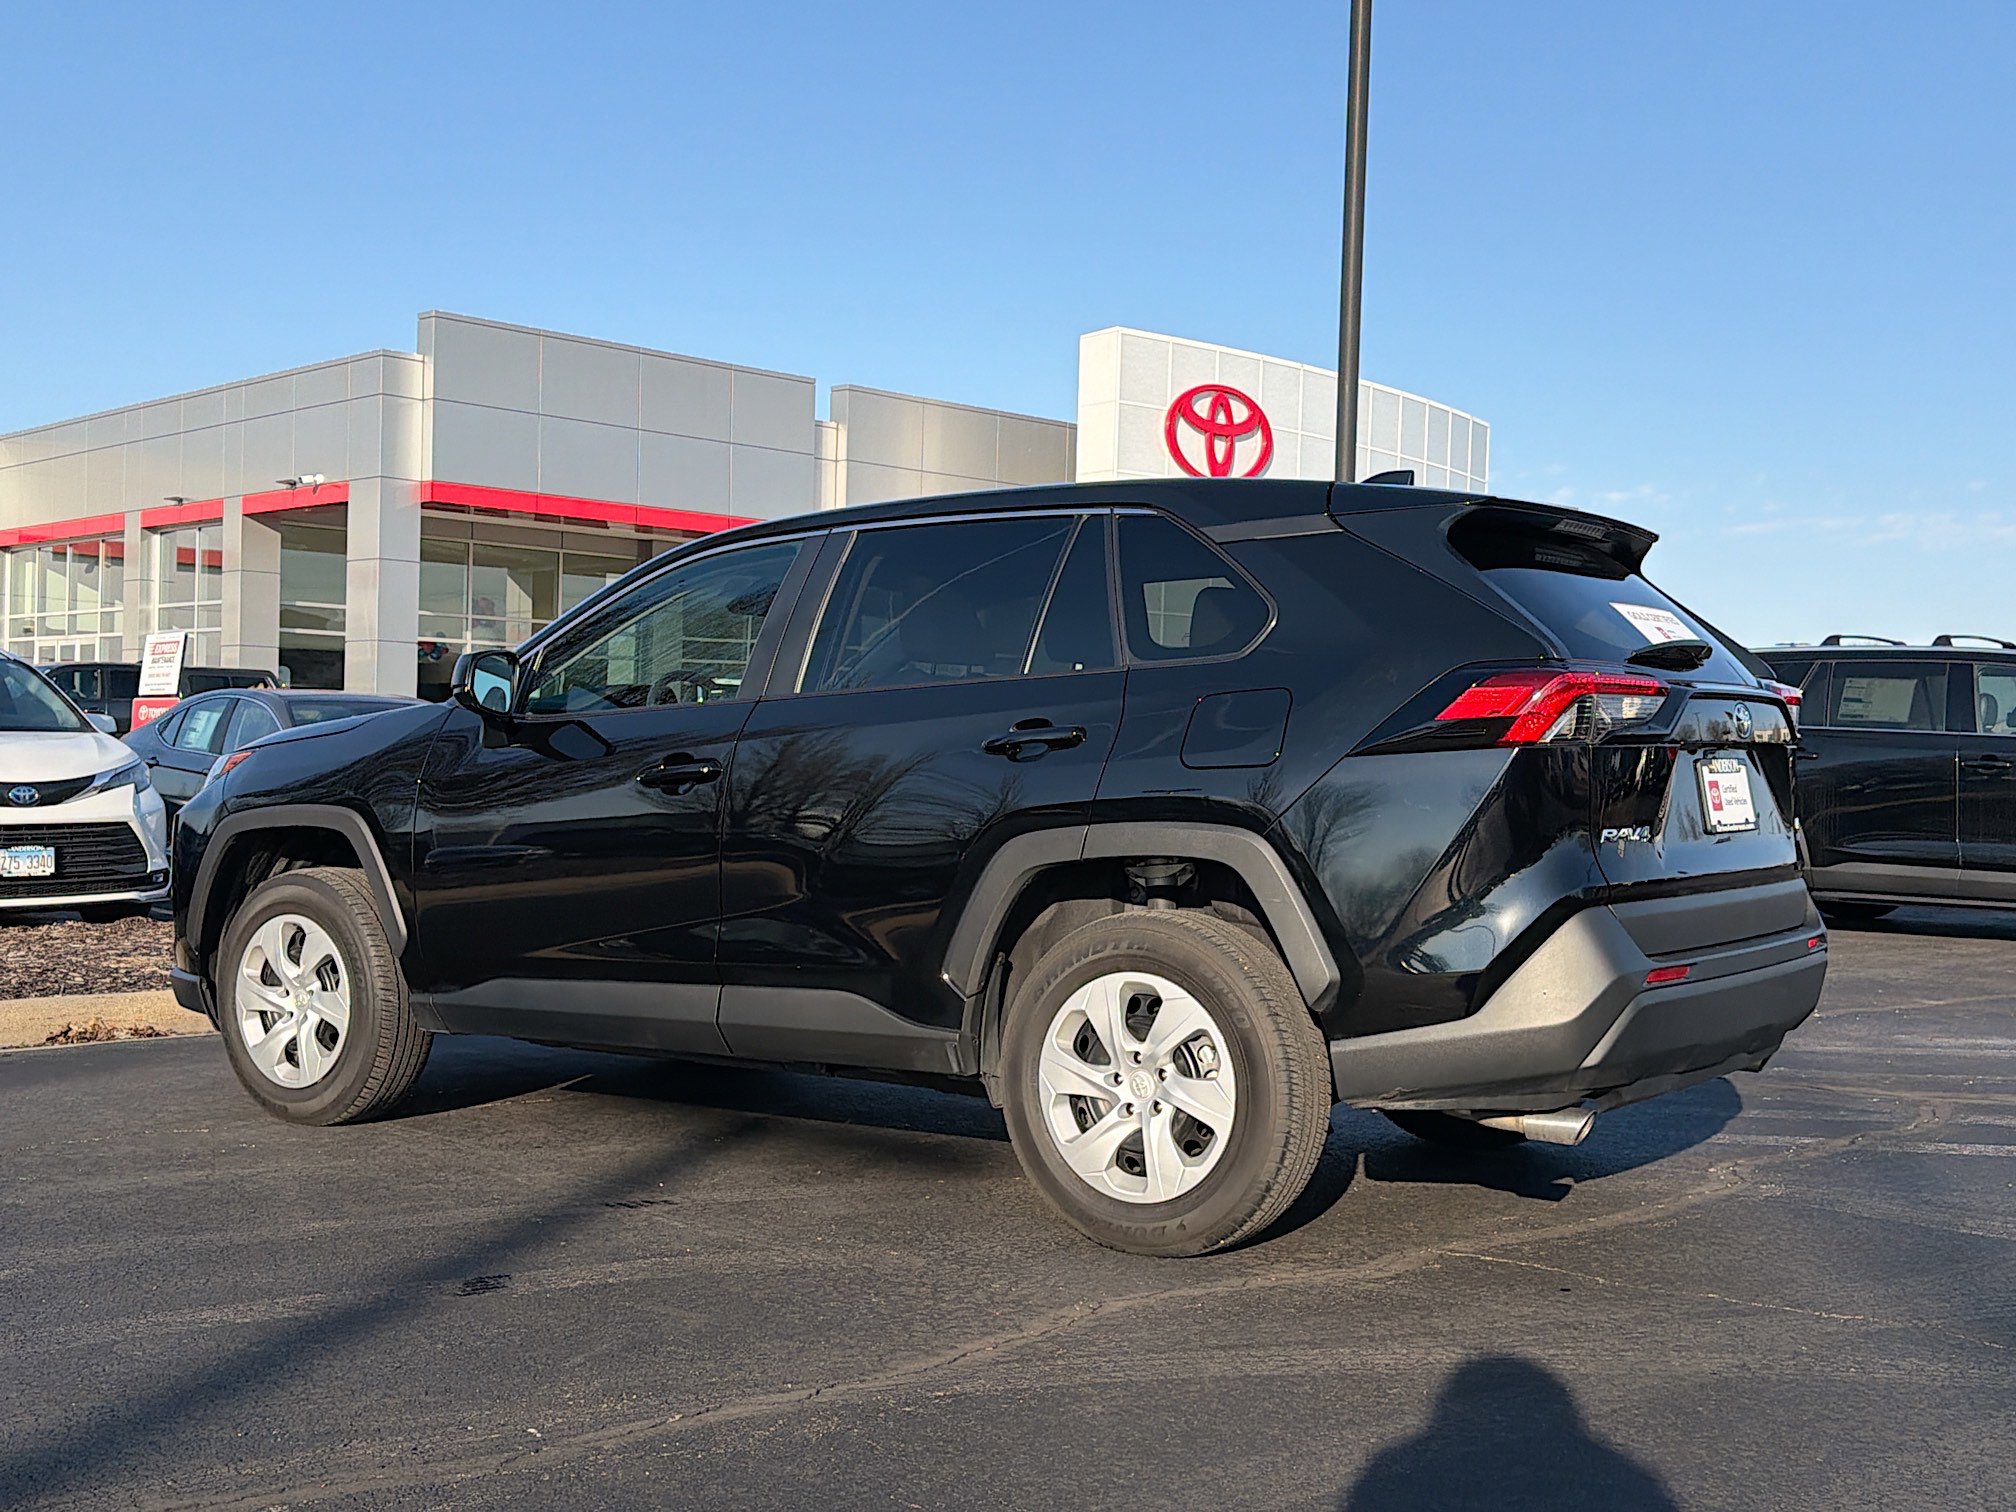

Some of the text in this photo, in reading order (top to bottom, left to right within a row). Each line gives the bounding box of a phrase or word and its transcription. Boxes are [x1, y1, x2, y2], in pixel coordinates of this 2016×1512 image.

[154, 642, 179, 654] EXPRESS
[148, 707, 170, 720] TOYO
[1600, 825, 1651, 844] RAV4
[26, 854, 53, 869] 3340
